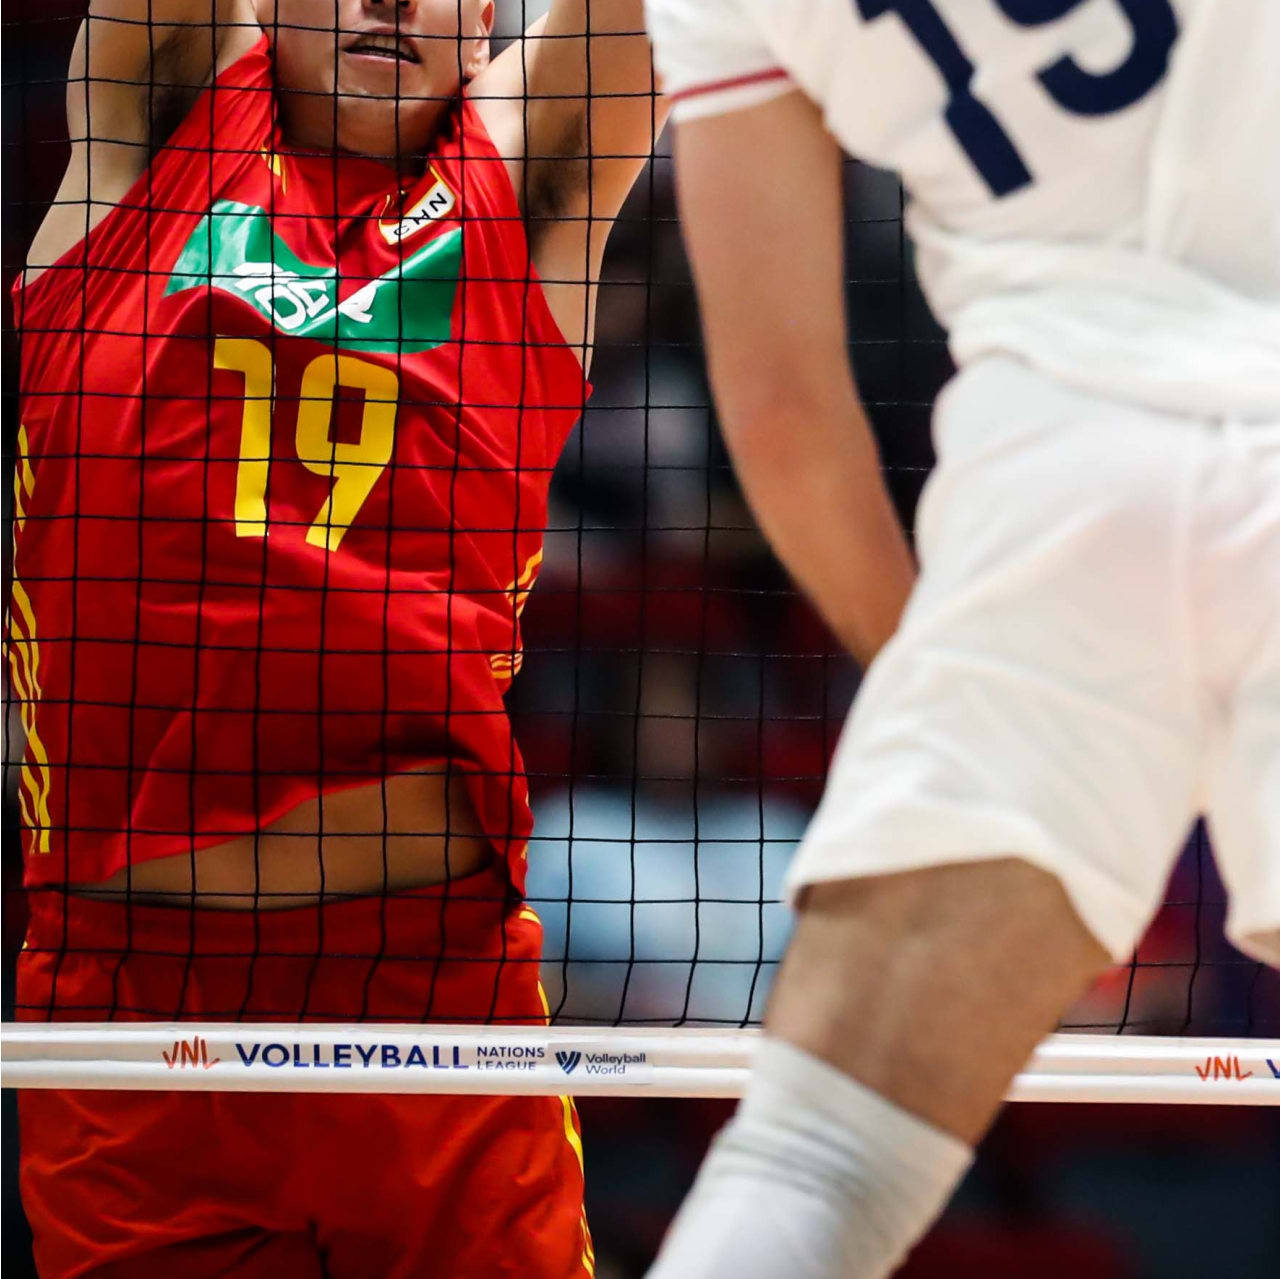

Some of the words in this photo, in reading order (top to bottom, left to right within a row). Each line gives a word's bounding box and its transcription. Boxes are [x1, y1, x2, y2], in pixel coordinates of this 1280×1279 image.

[212, 336, 400, 552] 19
[162, 1035, 221, 1070] VNL
[235, 1042, 469, 1070] VOLLEYBALL
[476, 1045, 546, 1059] NATIONS
[585, 1052, 647, 1065] Volleyball
[476, 1059, 537, 1071] LEAGUE
[585, 1064, 626, 1075] World
[1194, 1053, 1254, 1081] VNL
